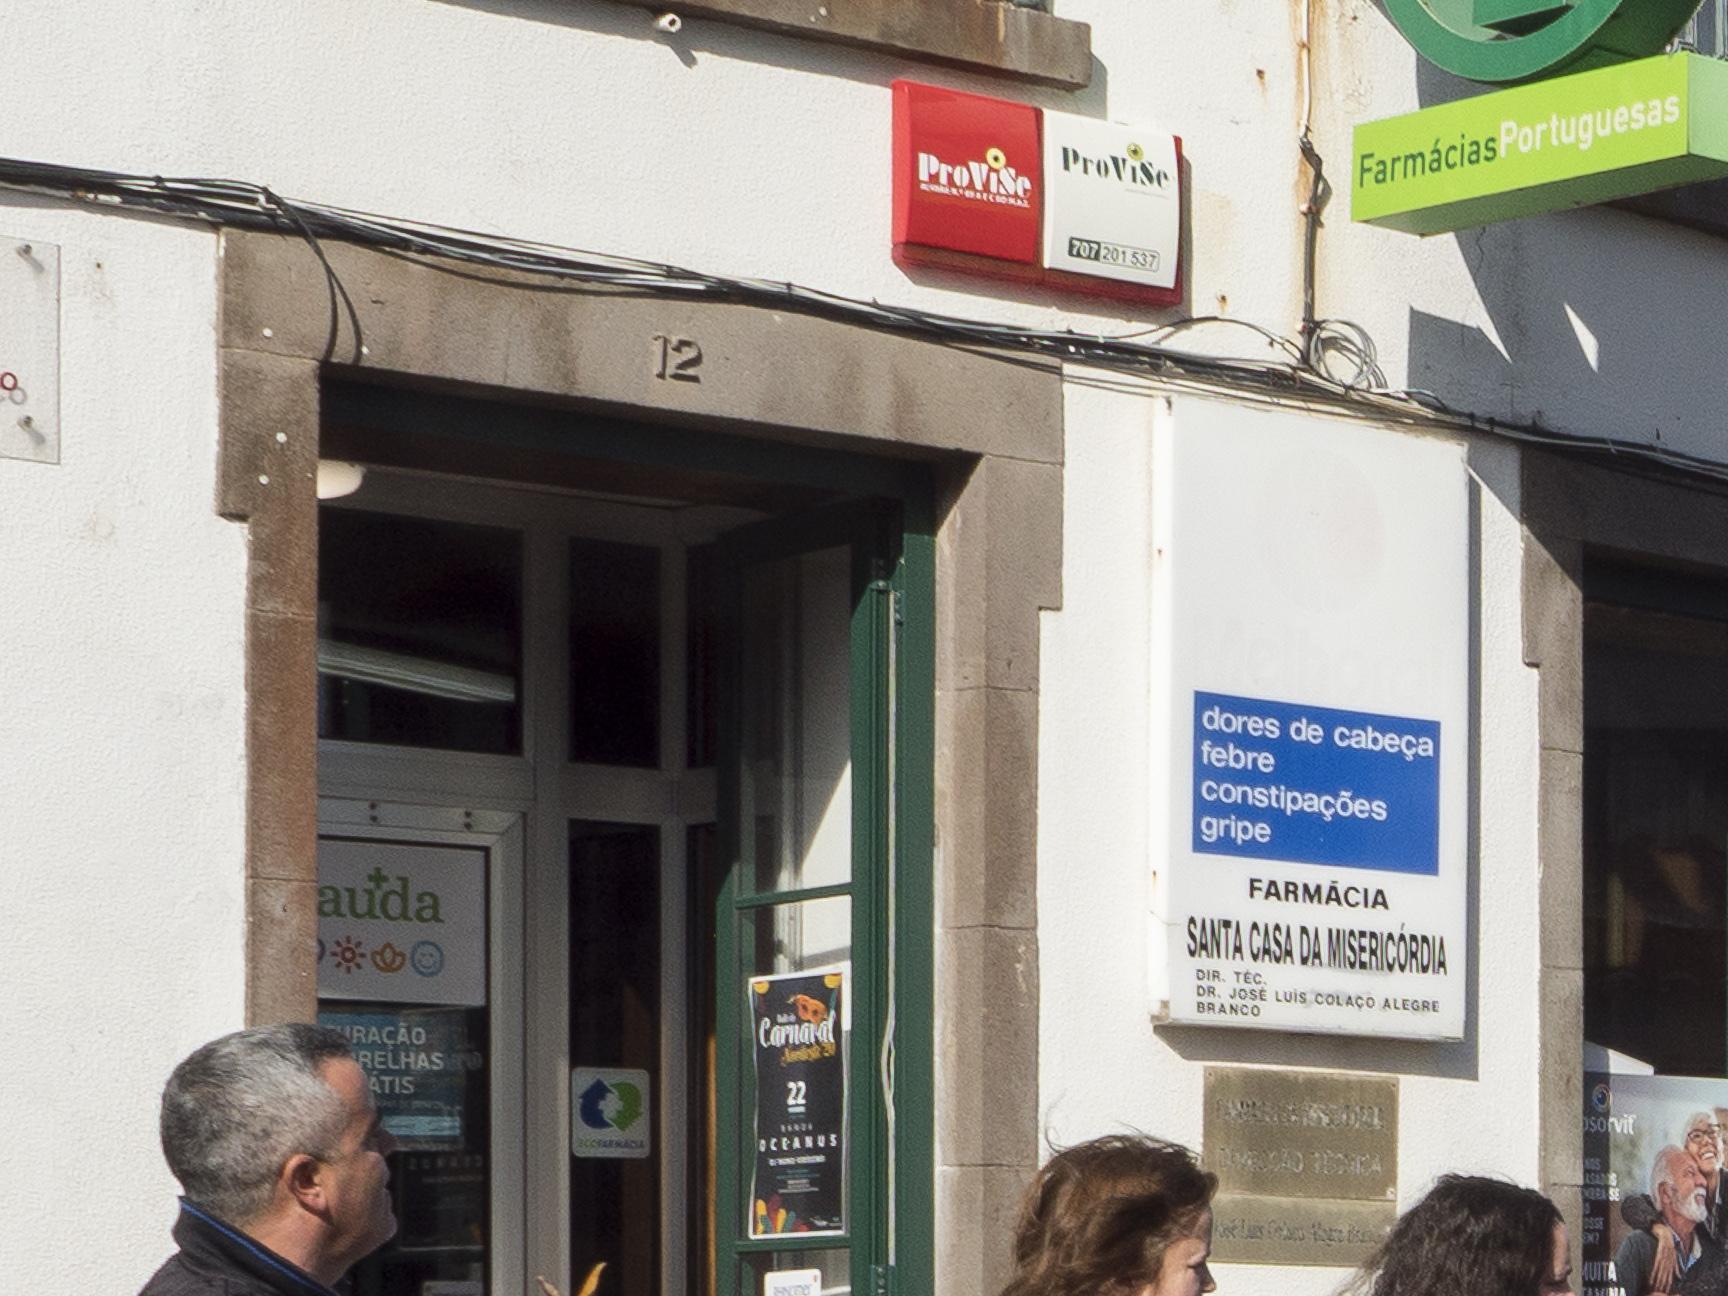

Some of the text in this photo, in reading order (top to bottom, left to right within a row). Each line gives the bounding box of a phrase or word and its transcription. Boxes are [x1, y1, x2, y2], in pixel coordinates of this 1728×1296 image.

[1071, 239, 1157, 268] 707 201 537
[652, 334, 703, 384] 12
[1202, 705, 1434, 761] dores de cabeça
[1200, 740, 1275, 773] febre
[1201, 779, 1388, 822] constipações
[1200, 814, 1272, 844] gripe
[1248, 877, 1390, 911] FARMÁCIA
[1187, 915, 1448, 976] SANTA CASA DA MISERICÓRDIA
[1195, 968, 1268, 985] DIR. TÉC.
[1196, 985, 1222, 998] DR.
[1229, 986, 1268, 1002] JOSÉ
[1314, 992, 1376, 1011] COLAÇO
[1382, 998, 1440, 1013] ALEGRE
[1196, 1001, 1261, 1017] BRANCO
[759, 1010, 837, 1048] Carnaval
[354, 1051, 445, 1071] RELHAS
[786, 1081, 807, 1105] 22
[758, 1133, 838, 1152] OCEANUS
